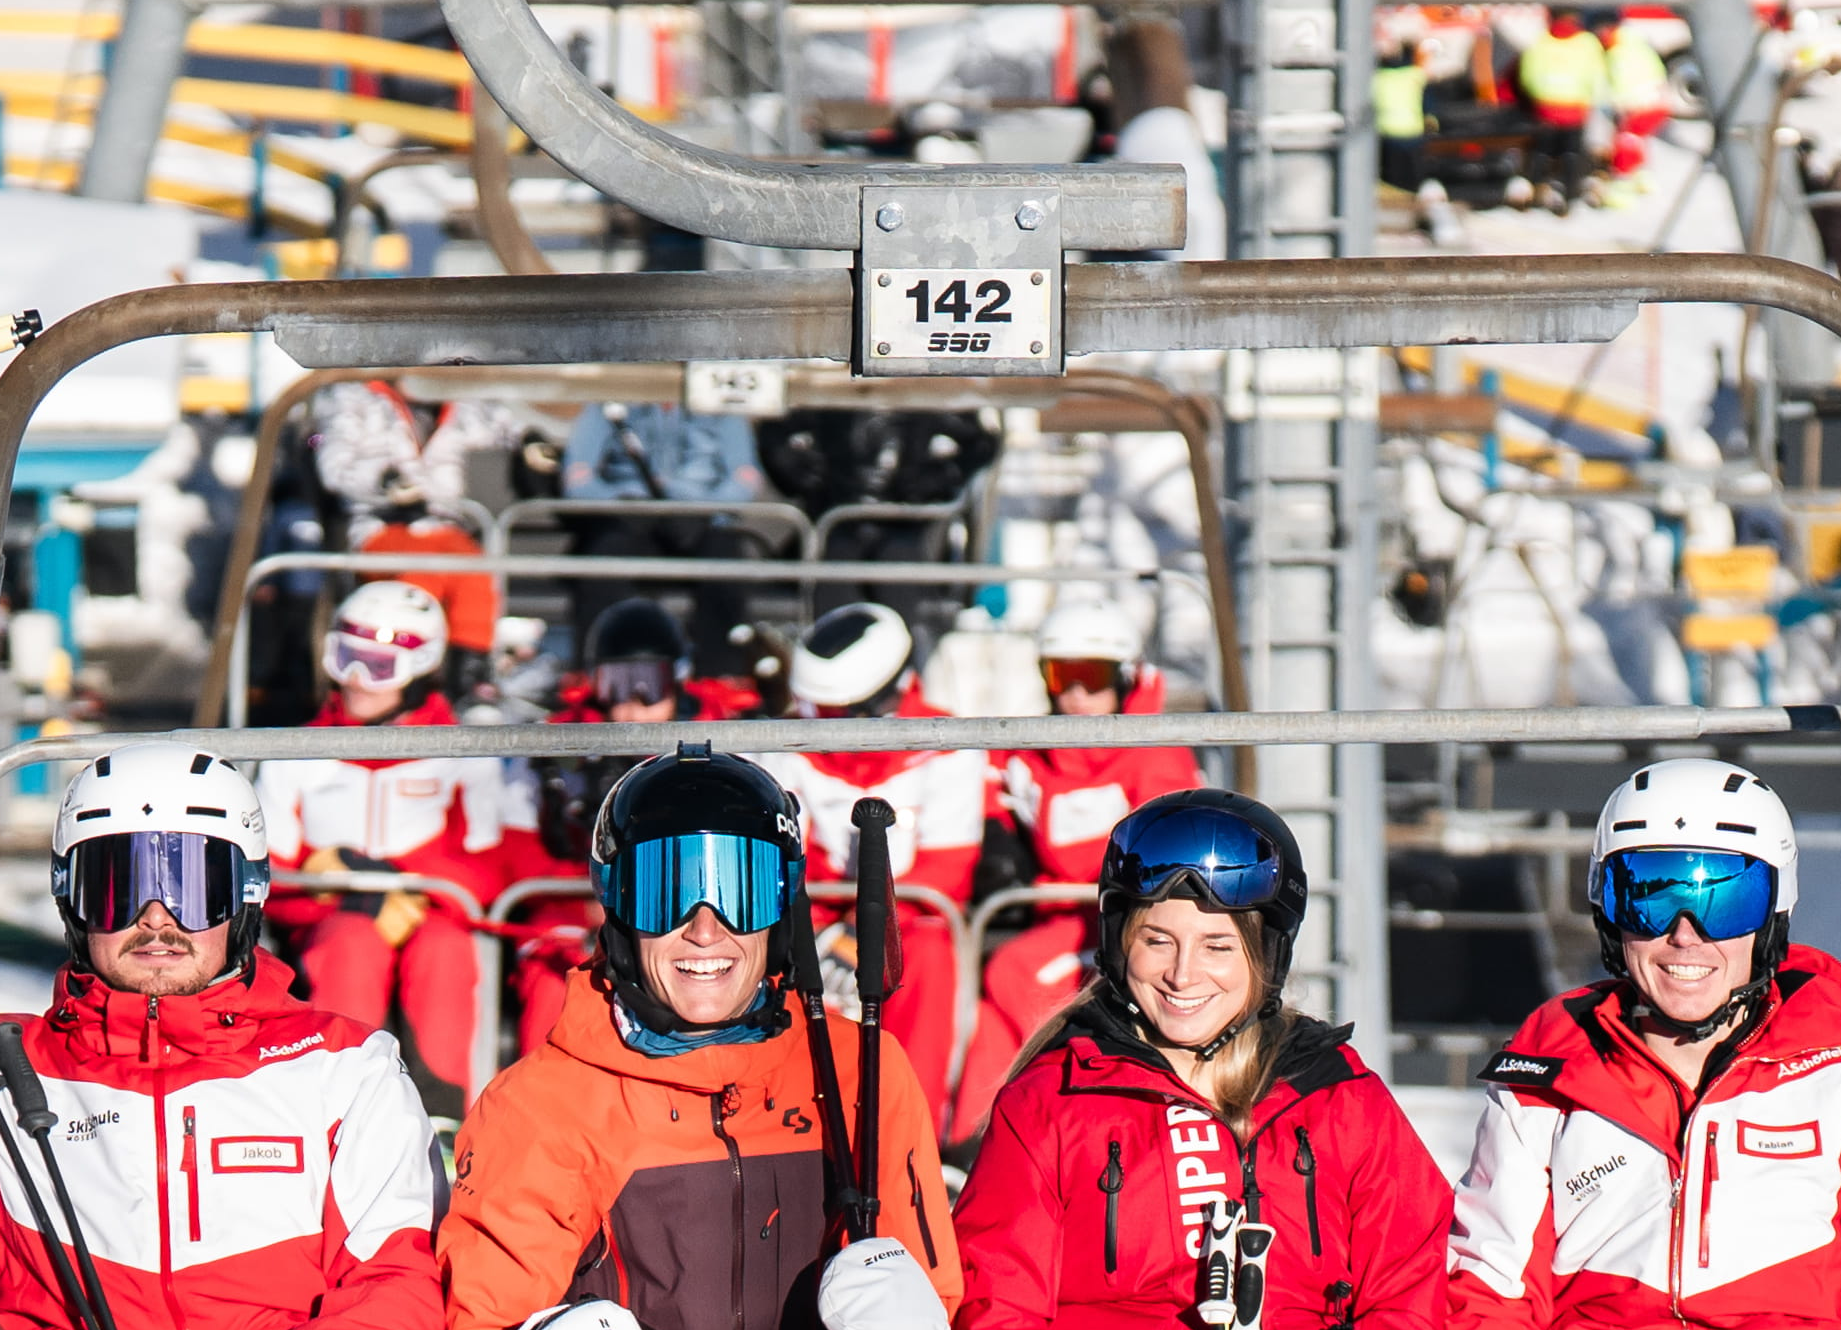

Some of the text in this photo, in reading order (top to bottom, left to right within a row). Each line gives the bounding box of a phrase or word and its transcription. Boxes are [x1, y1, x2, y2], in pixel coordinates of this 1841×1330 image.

[906, 279, 1012, 322] 142
[928, 332, 991, 352] SSG
[269, 1032, 325, 1057] Schöffel
[242, 1147, 282, 1159] Jakob
[1758, 1141, 1794, 1149] Fabian
[1566, 1155, 1627, 1195] SkiSchule
[864, 1249, 905, 1266] ziener
